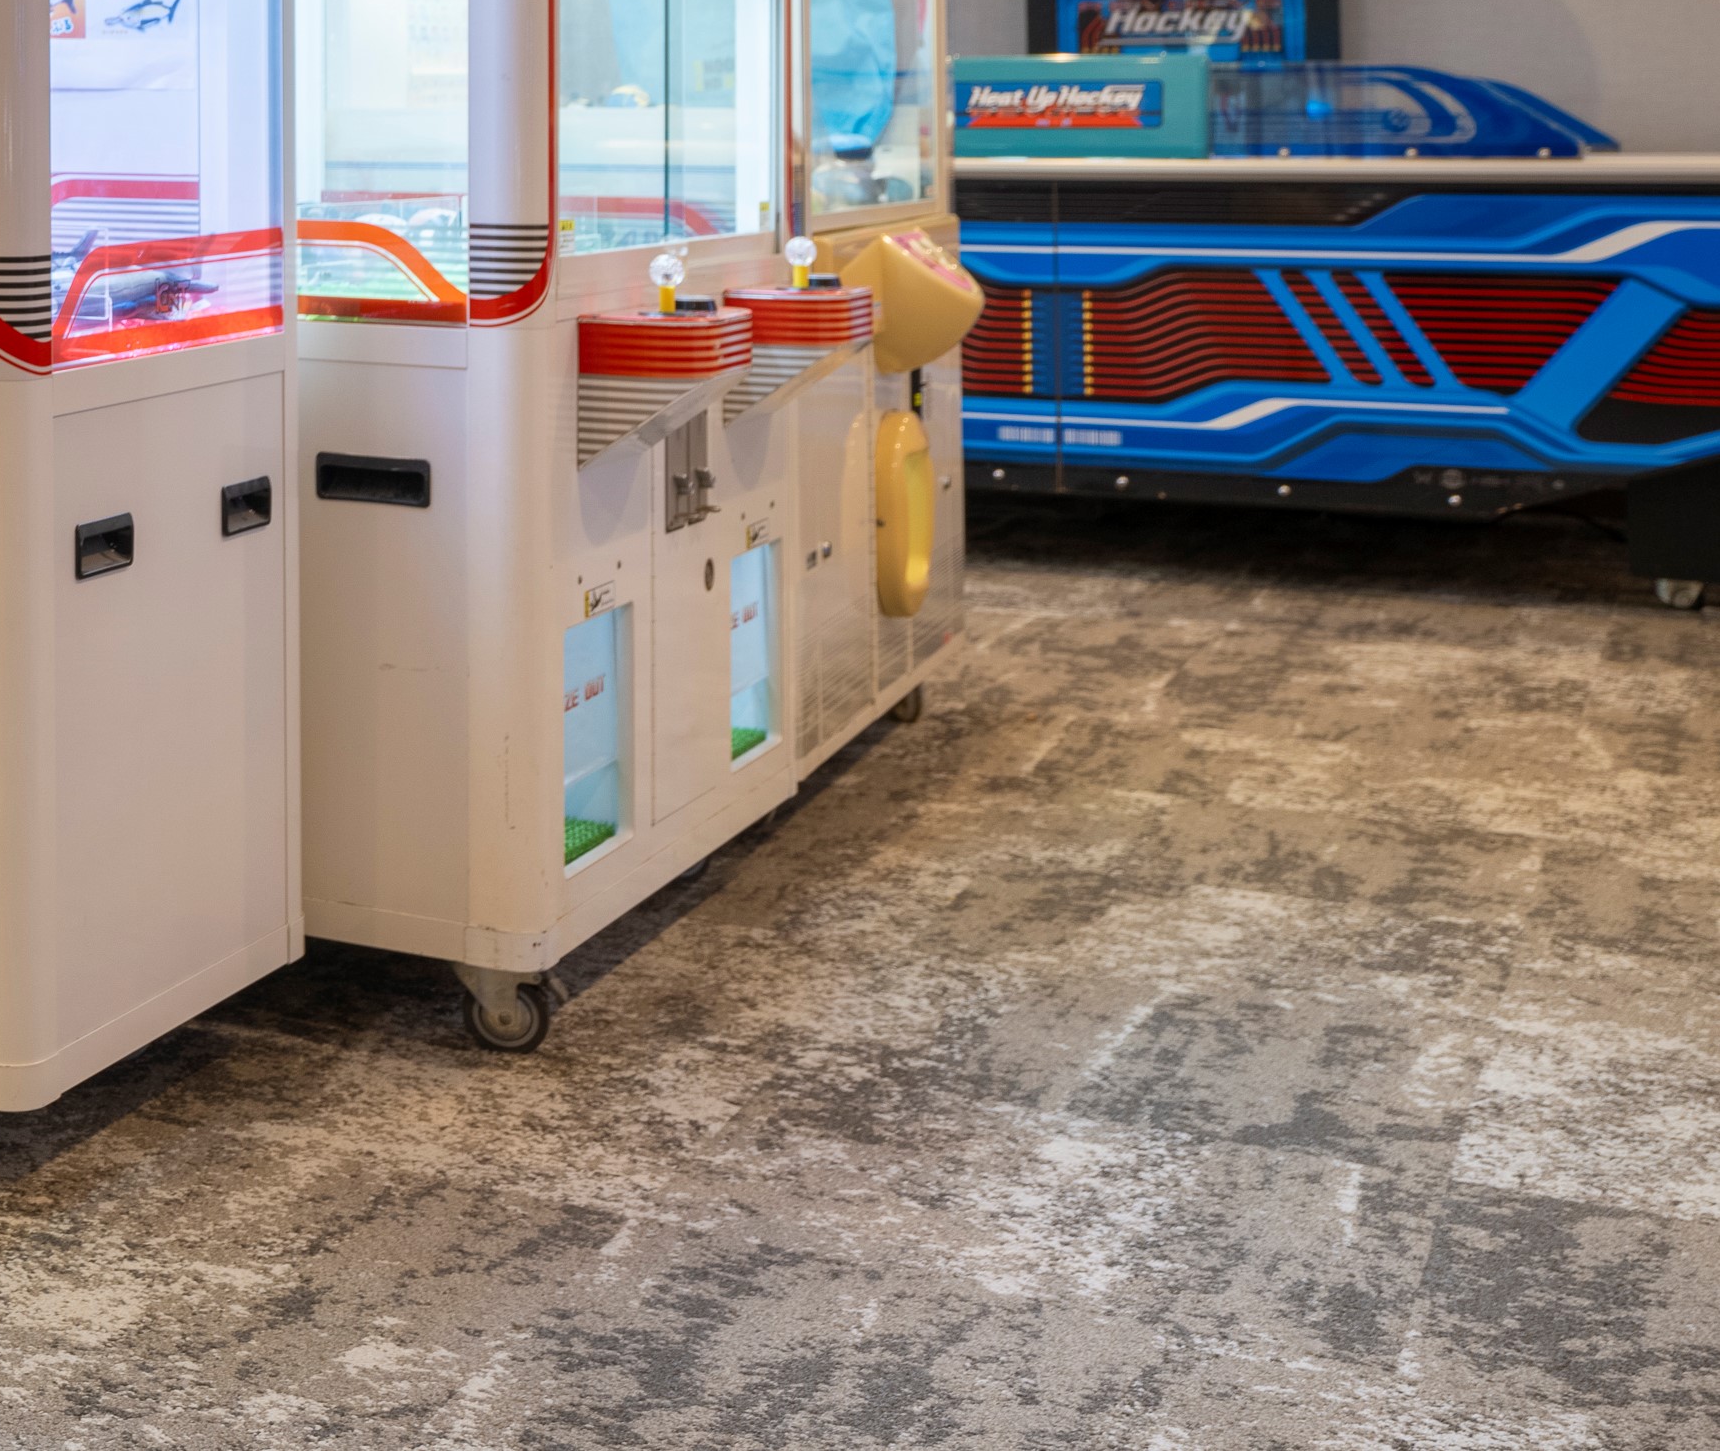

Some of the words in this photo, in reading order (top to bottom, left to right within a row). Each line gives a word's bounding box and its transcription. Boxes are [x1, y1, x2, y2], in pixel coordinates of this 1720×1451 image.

[1105, 8, 1249, 41] Hockey
[968, 85, 1024, 109] Heat
[1026, 85, 1058, 110] Up
[1057, 85, 1146, 109] Hockey
